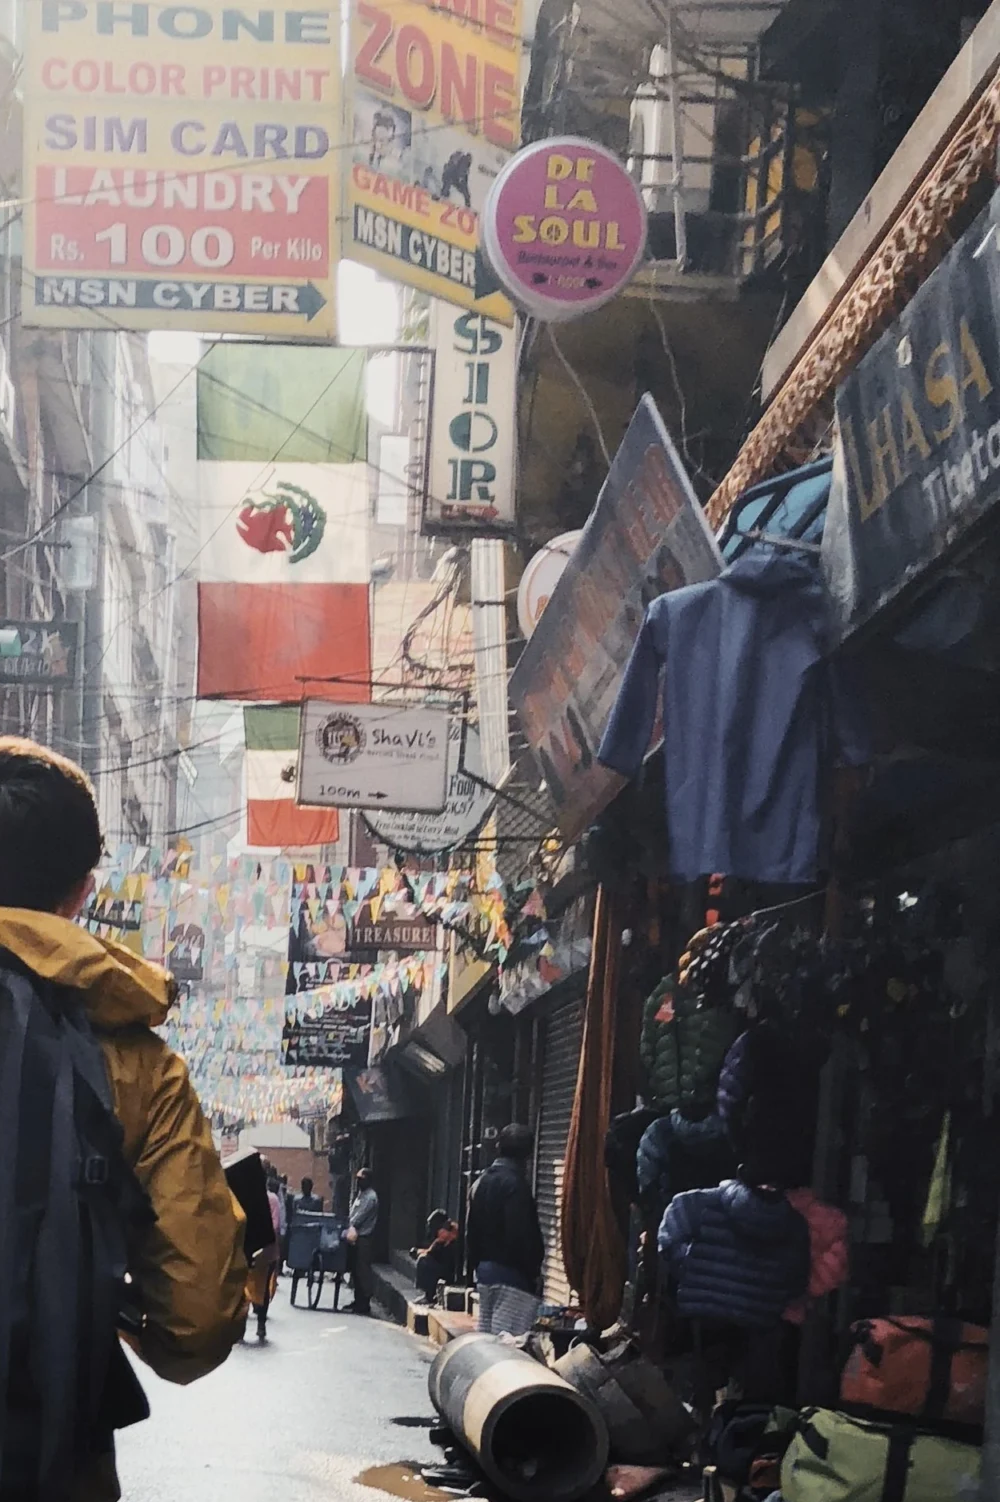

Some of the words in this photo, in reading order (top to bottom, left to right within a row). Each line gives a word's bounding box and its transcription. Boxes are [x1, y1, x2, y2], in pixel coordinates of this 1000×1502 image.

[41, 1, 330, 44] PHONE
[41, 57, 187, 96] COLOR
[202, 64, 331, 103] PRINT
[355, 2, 516, 147] ZONE
[44, 114, 148, 154] SIM
[170, 121, 330, 160] CARD
[54, 168, 313, 214] LAUNDRY
[352, 162, 431, 218] GAME
[547, 154, 596, 183] DE
[544, 184, 598, 213] LA
[50, 233, 85, 262] Rs.
[95, 222, 235, 269] 100
[250, 235, 281, 260] Per
[286, 237, 323, 261] Kilo
[356, 206, 401, 256] MSN
[408, 227, 477, 288] CYBER
[512, 214, 627, 251] SOUL
[43, 278, 137, 305] MSN
[152, 281, 301, 312] CYBER
[840, 317, 993, 524] LHASA
[354, 926, 432, 944] TREASURE
